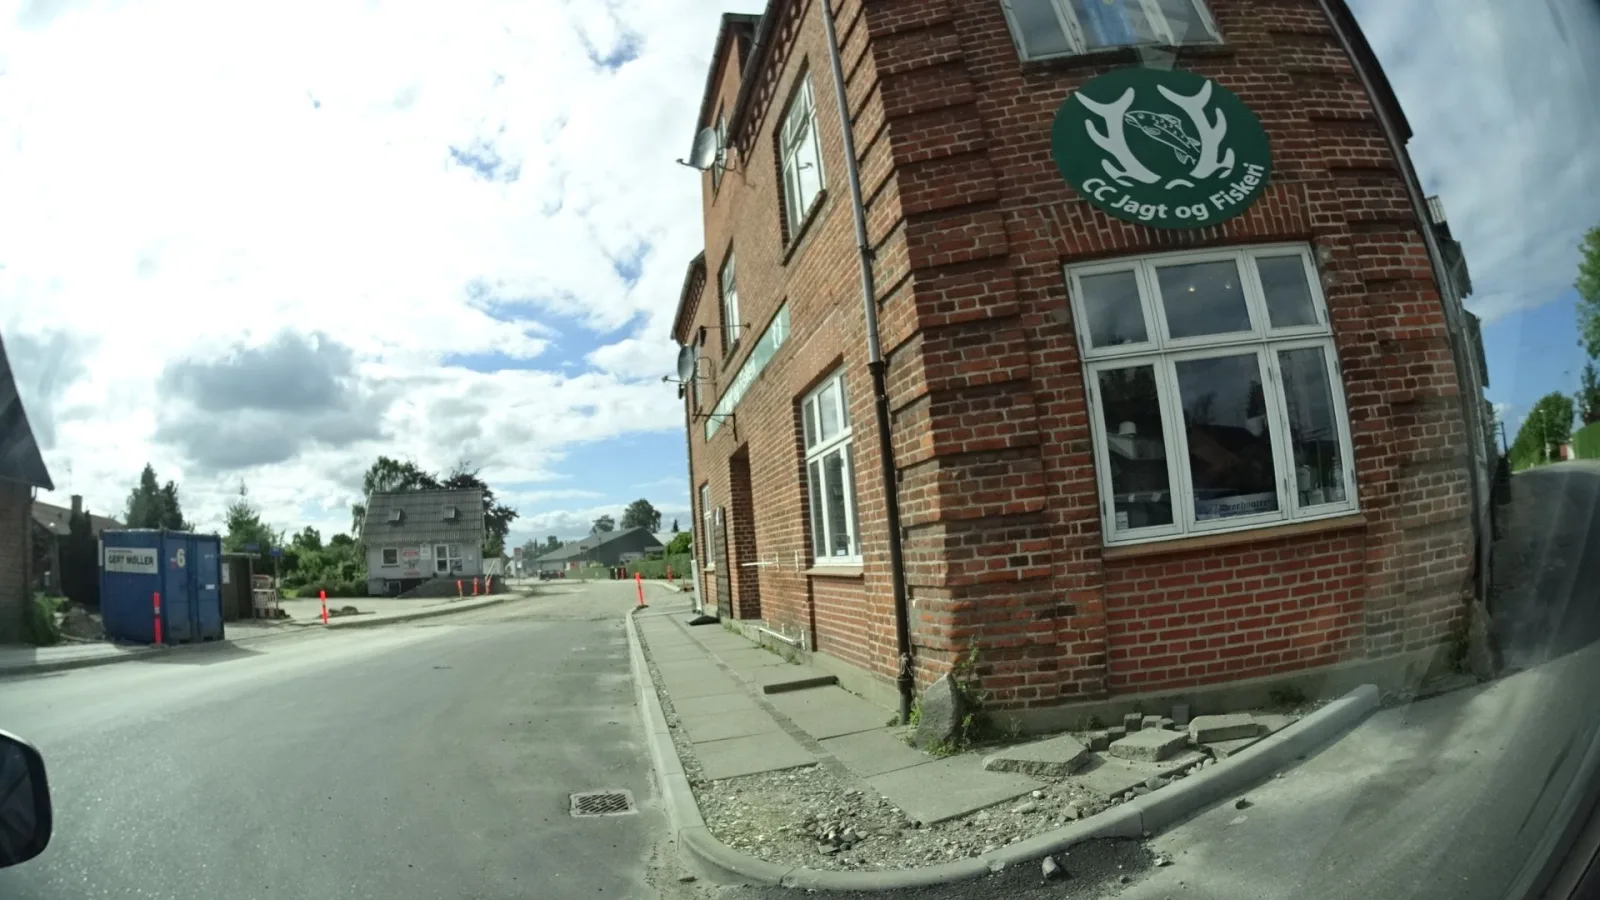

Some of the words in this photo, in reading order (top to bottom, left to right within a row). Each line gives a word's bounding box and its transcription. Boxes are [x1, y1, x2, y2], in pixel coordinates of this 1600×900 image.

[1082, 178, 1117, 201] CC
[1110, 195, 1168, 221] Jagt
[1175, 203, 1209, 221] og
[1209, 162, 1265, 211] Fiskeri
[176, 548, 186, 568] 6
